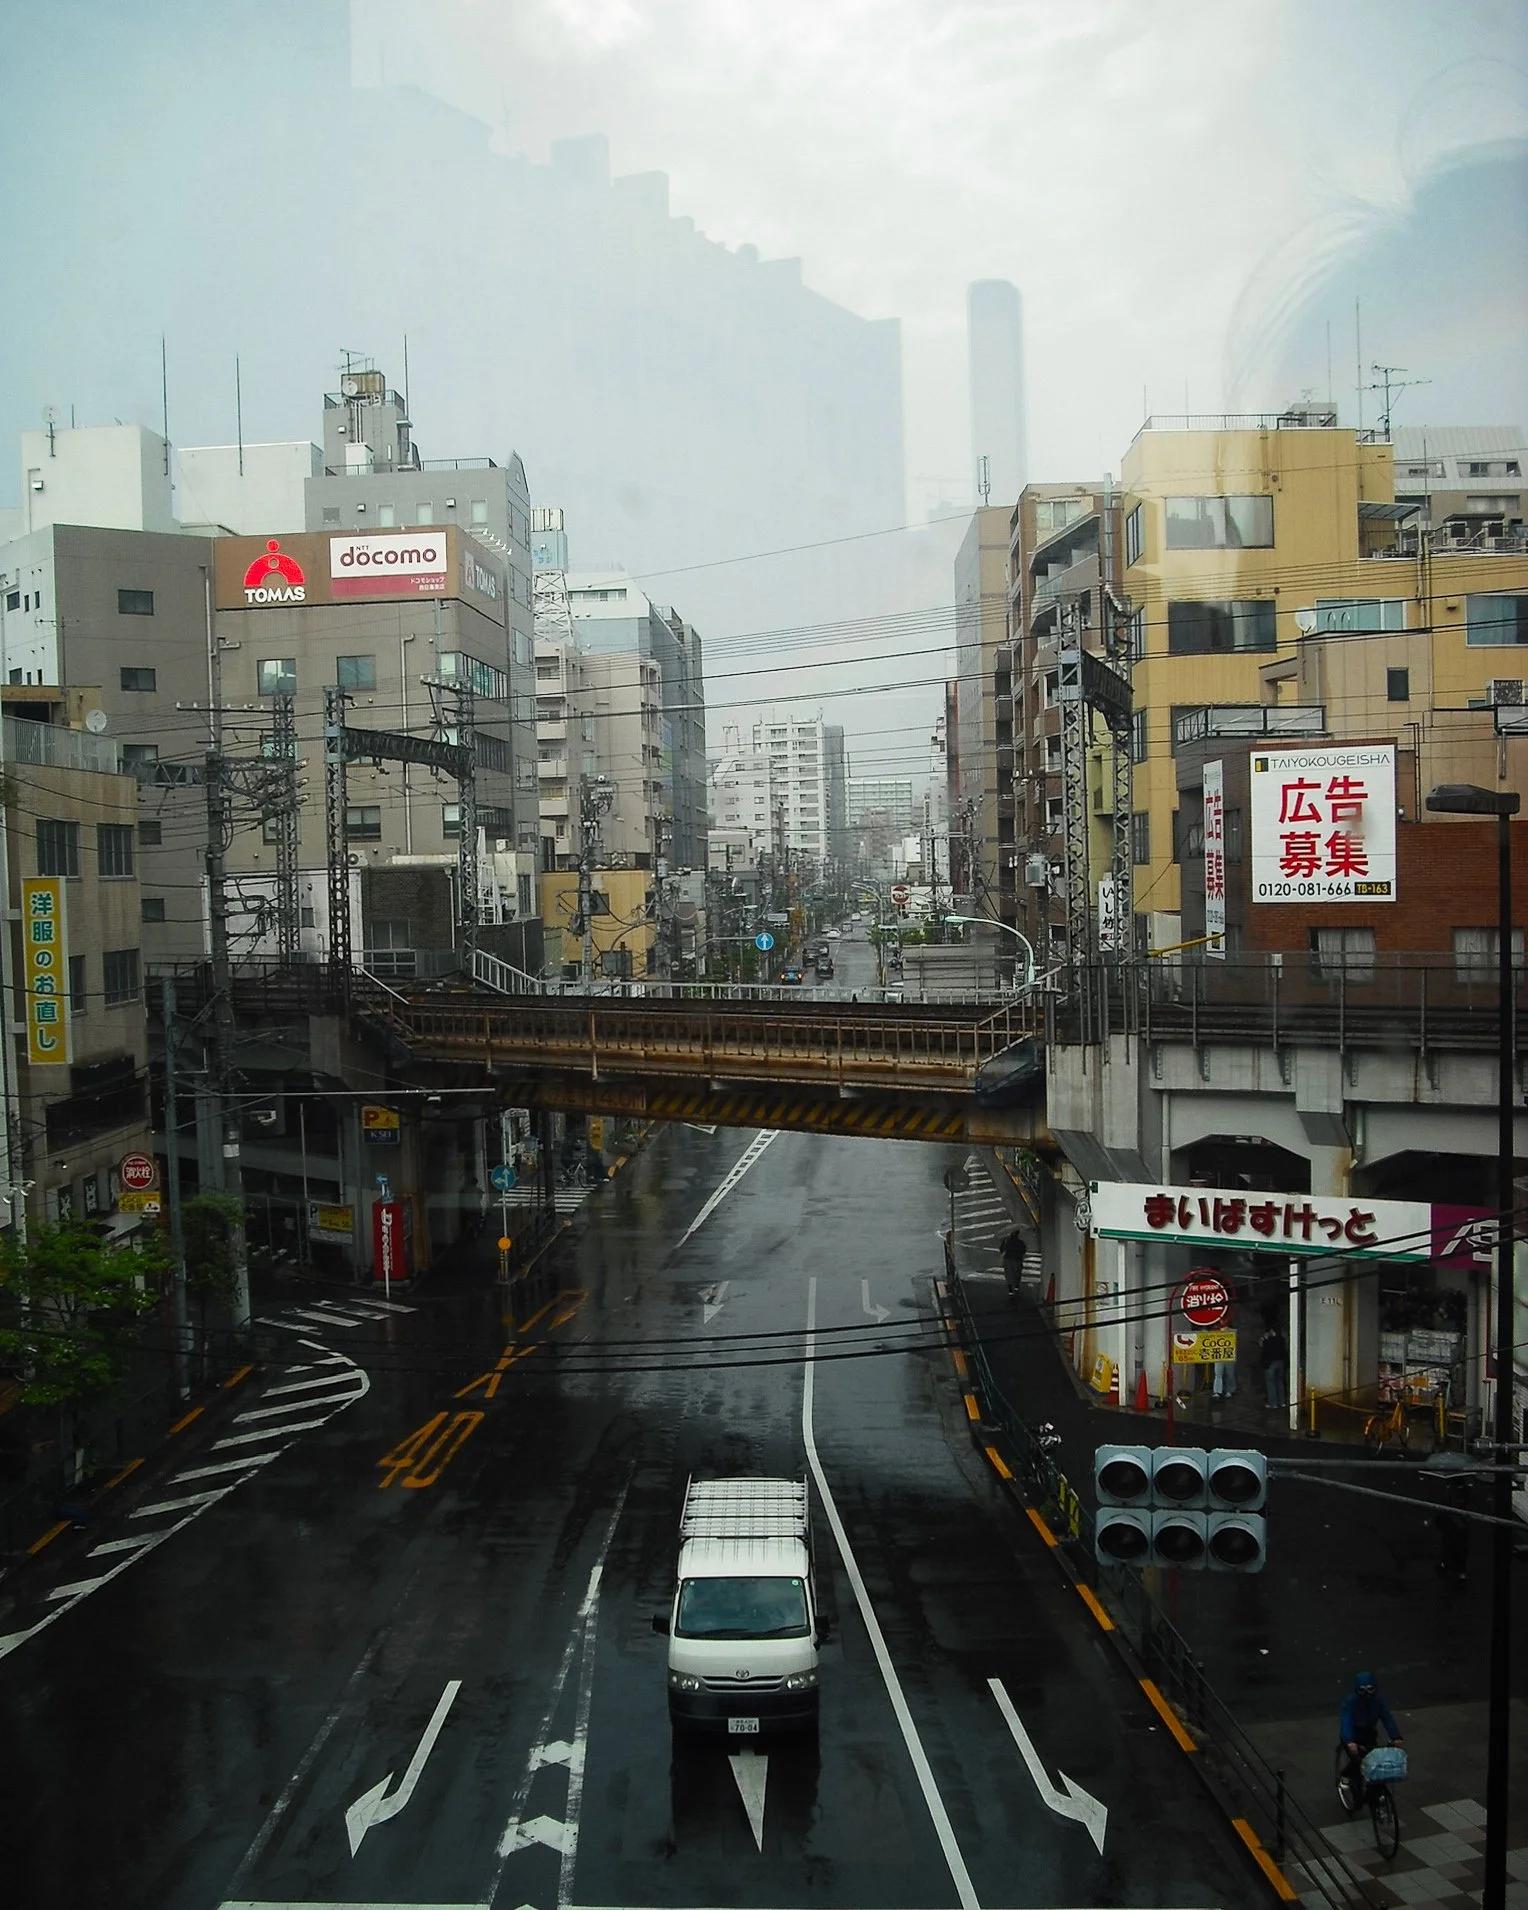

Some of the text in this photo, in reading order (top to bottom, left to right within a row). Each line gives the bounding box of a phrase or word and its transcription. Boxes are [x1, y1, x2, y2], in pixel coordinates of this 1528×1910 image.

[340, 546, 437, 567] docomo
[475, 564, 496, 599] TOMAS
[244, 587, 306, 603] TOMAS
[1270, 753, 1390, 769] TAIYOKOUGEISHA
[1278, 775, 1369, 824] 広告
[1279, 830, 1369, 879] 募集
[1258, 882, 1351, 897] 0120-081-666
[1356, 883, 1389, 894] TB-163
[31, 891, 57, 1051] 洋服のお直し
[364, 1110, 379, 1127] P
[125, 1166, 151, 1179] 消火栓
[1143, 1192, 1379, 1244] まいばすけっと
[1198, 1347, 1234, 1360] 壱番屋
[376, 1411, 485, 1488] 40
